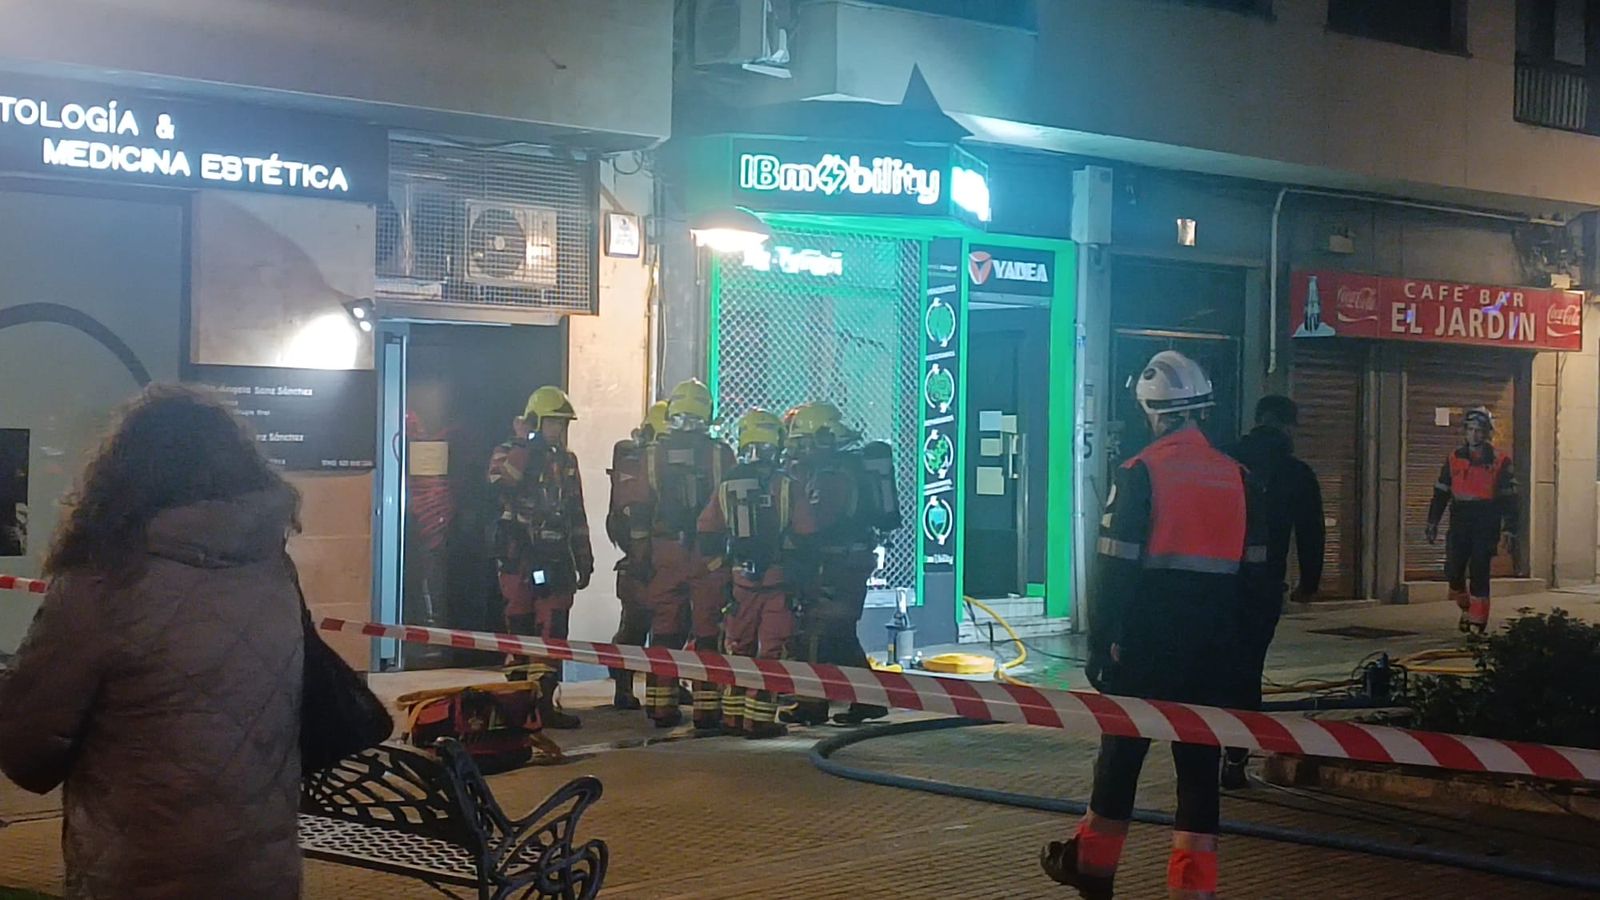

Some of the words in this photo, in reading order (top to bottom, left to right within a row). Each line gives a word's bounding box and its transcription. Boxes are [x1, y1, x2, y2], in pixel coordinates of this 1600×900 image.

[155, 114, 175, 139] &
[43, 138, 191, 177] MEDICINA
[200, 153, 349, 192] ESTÉTICA
[992, 259, 1048, 282] YADEA
[1479, 288, 1524, 307] BAR
[1391, 301, 1423, 335] EL
[1434, 305, 1536, 342] JARDIN
